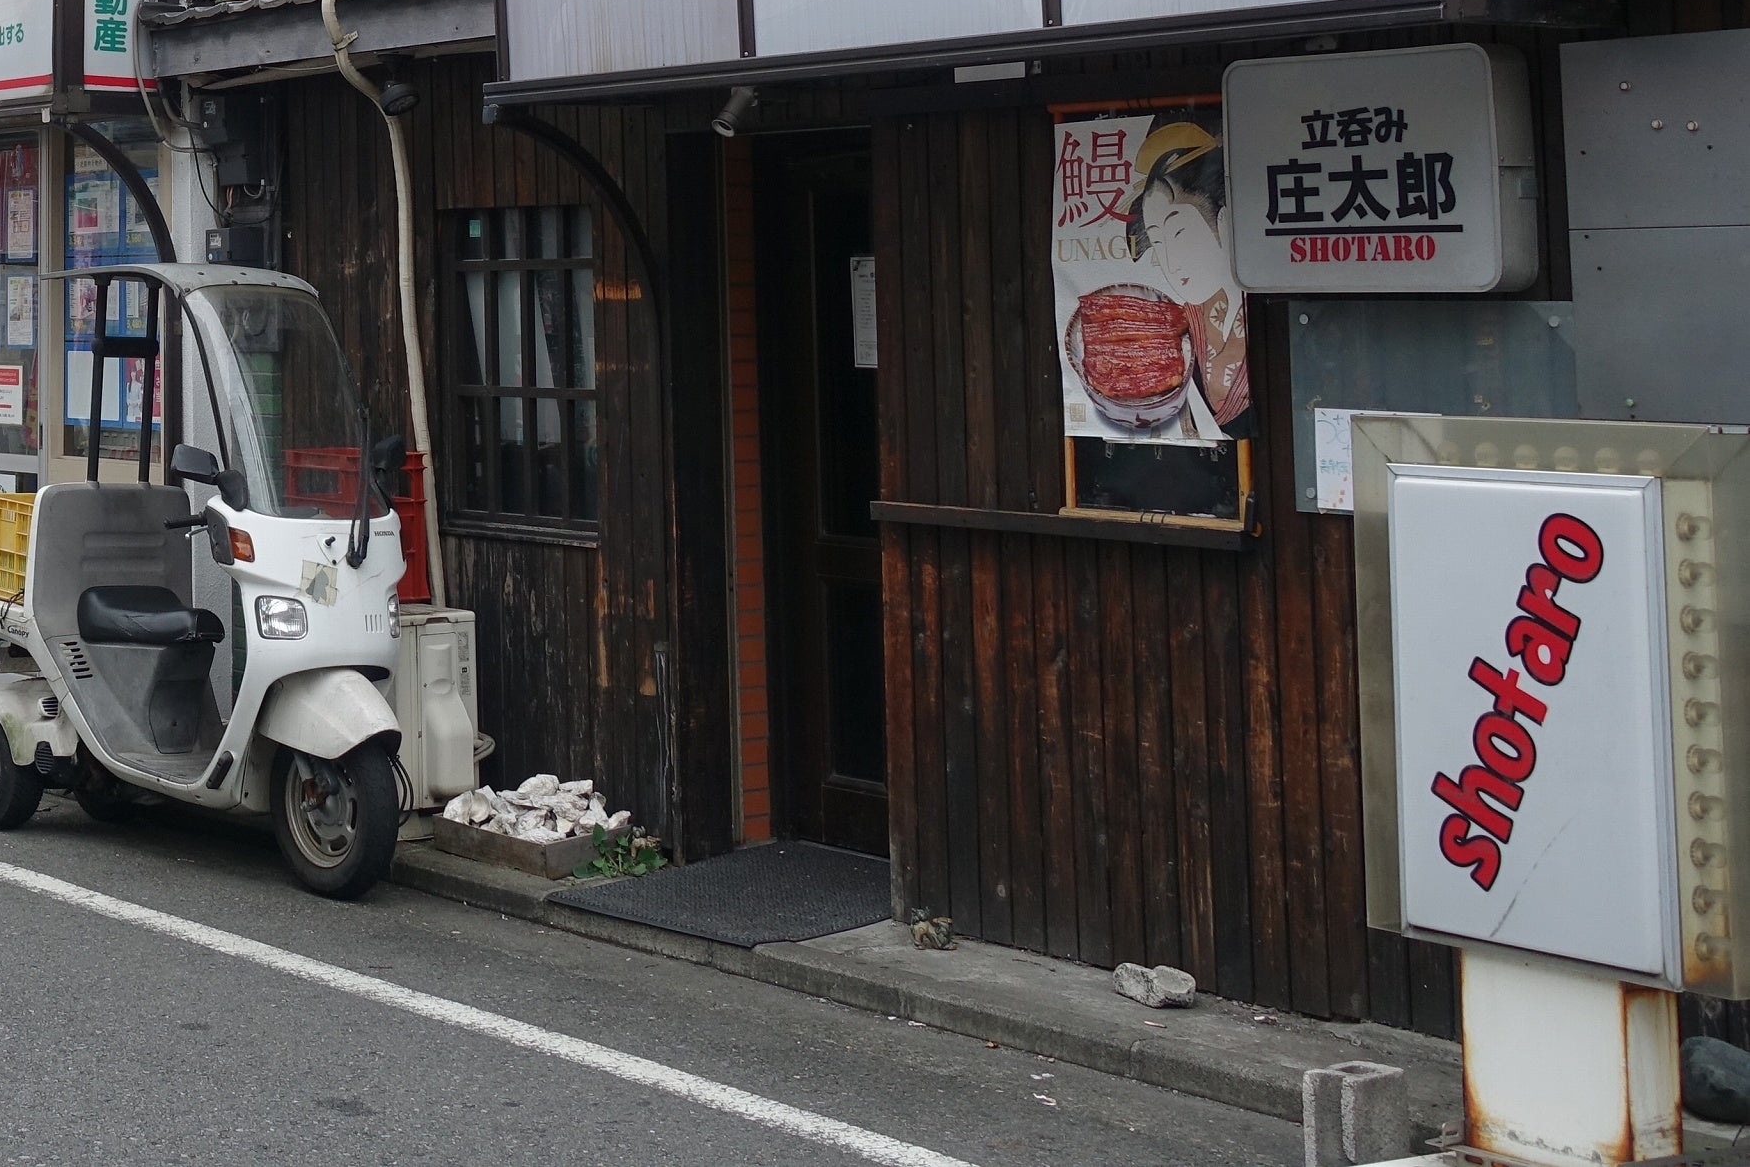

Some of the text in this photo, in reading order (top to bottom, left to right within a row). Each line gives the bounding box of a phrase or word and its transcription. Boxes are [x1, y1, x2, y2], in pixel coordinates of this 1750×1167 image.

[1300, 105, 1409, 150] 立呑み
[1056, 129, 1139, 228] 鰻
[1266, 152, 1457, 226] 庄太郎
[1057, 234, 1139, 262] UNAGI
[1290, 234, 1436, 263] SHOTARO
[8, 625, 29, 638] Canopy
[1430, 511, 1605, 892] shotaro
